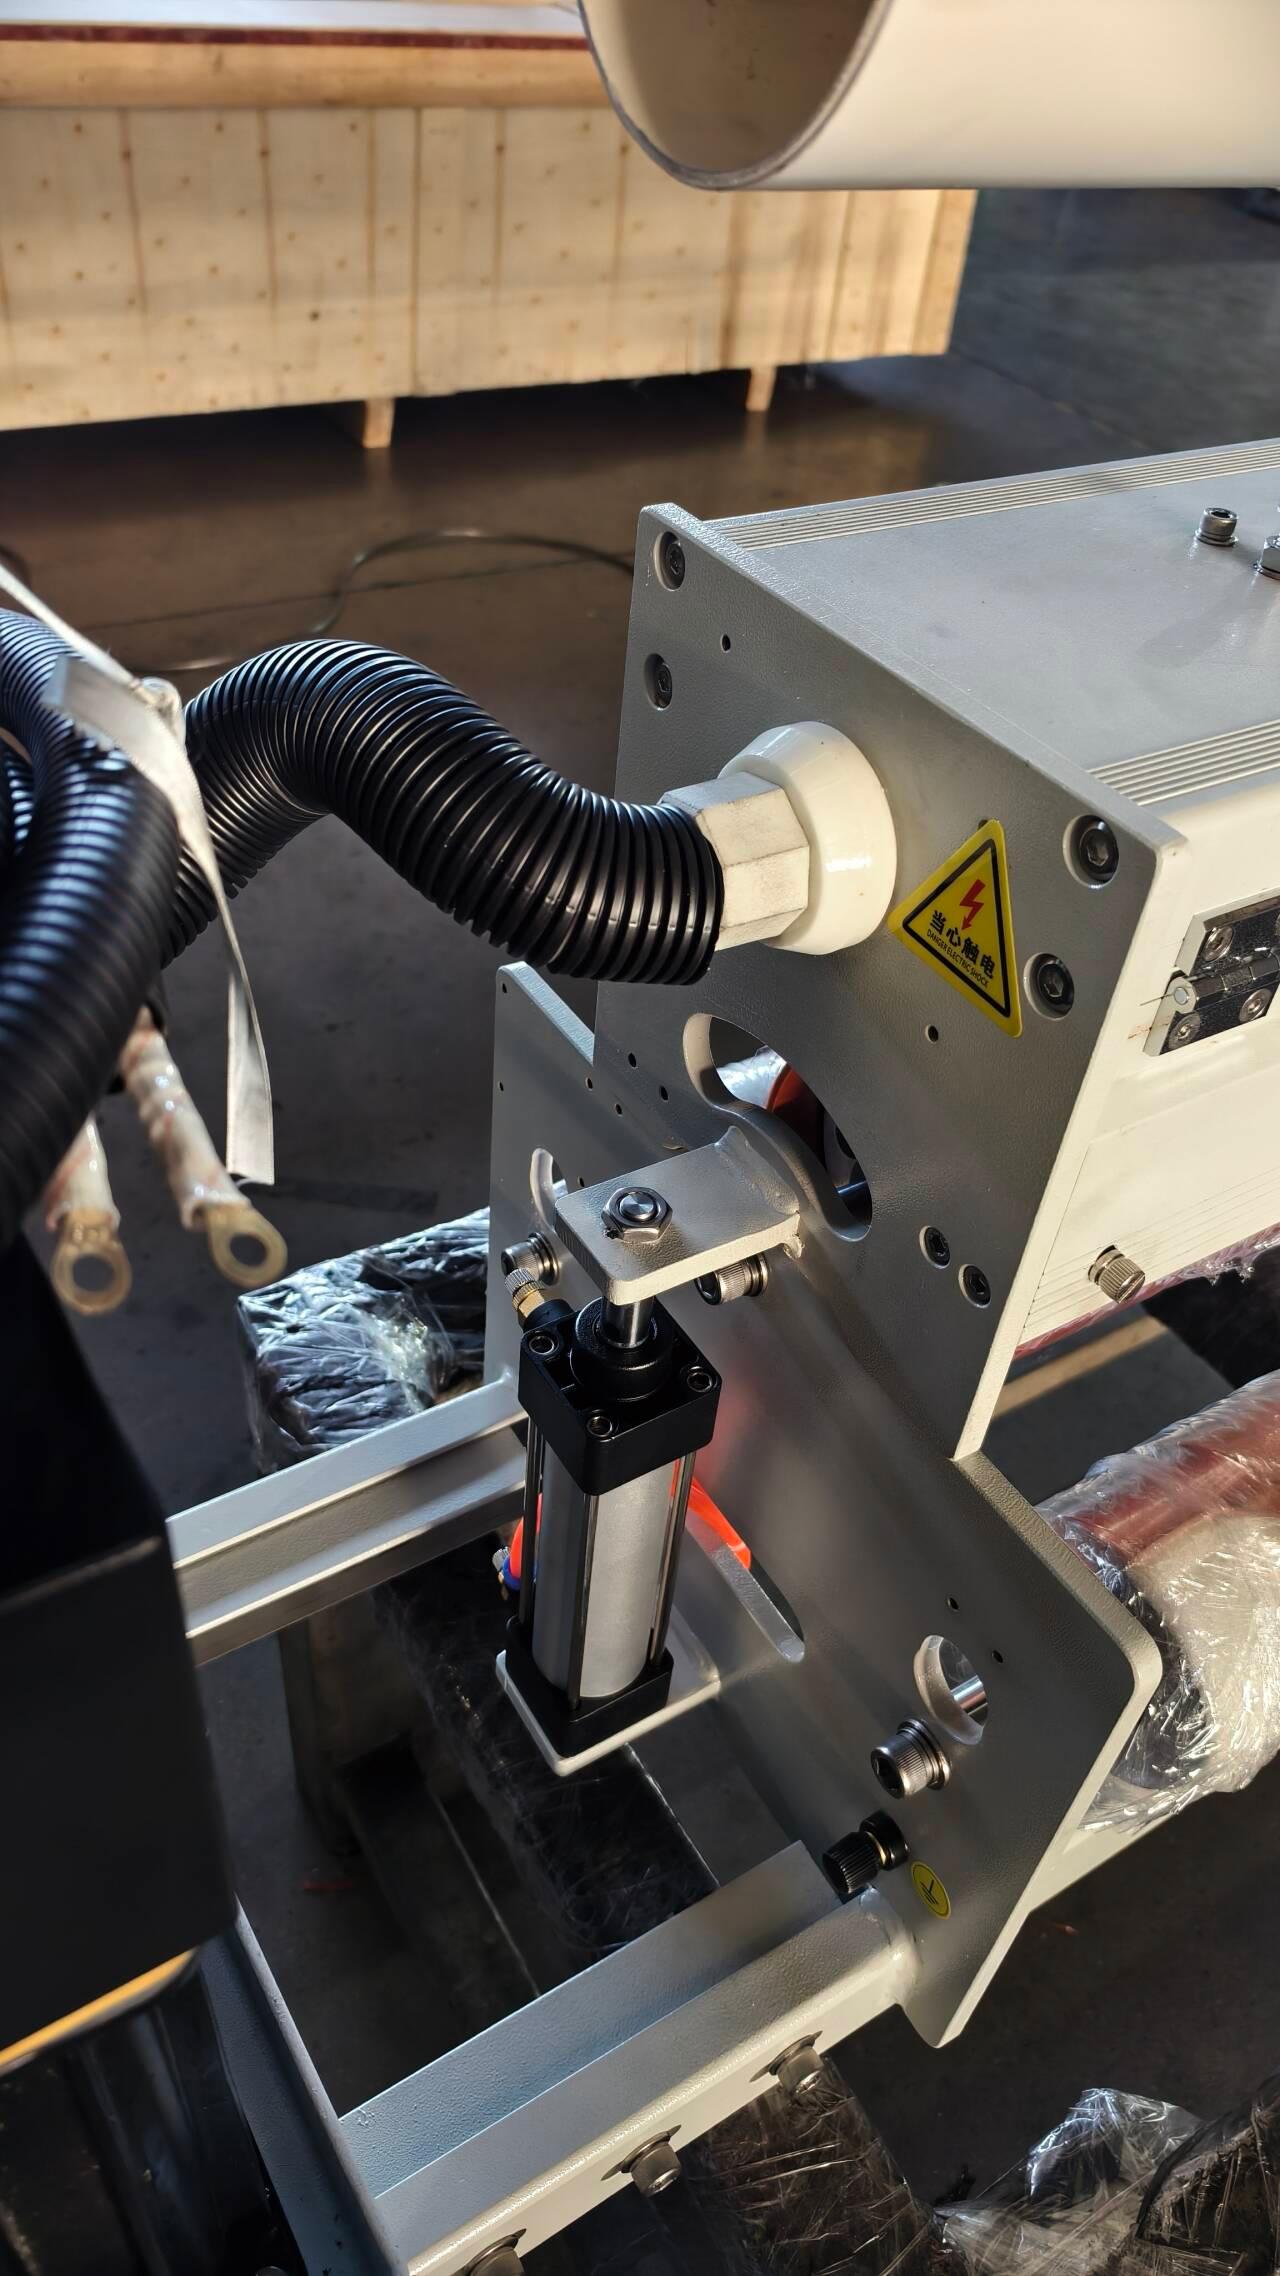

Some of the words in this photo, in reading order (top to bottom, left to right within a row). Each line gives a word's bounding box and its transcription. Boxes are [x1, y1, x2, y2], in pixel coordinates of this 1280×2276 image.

[927, 929, 948, 952] DANGER
[946, 947, 971, 973] ELECTRIC
[970, 968, 989, 988] SHOCK
[929, 910, 995, 980] 当心触电
